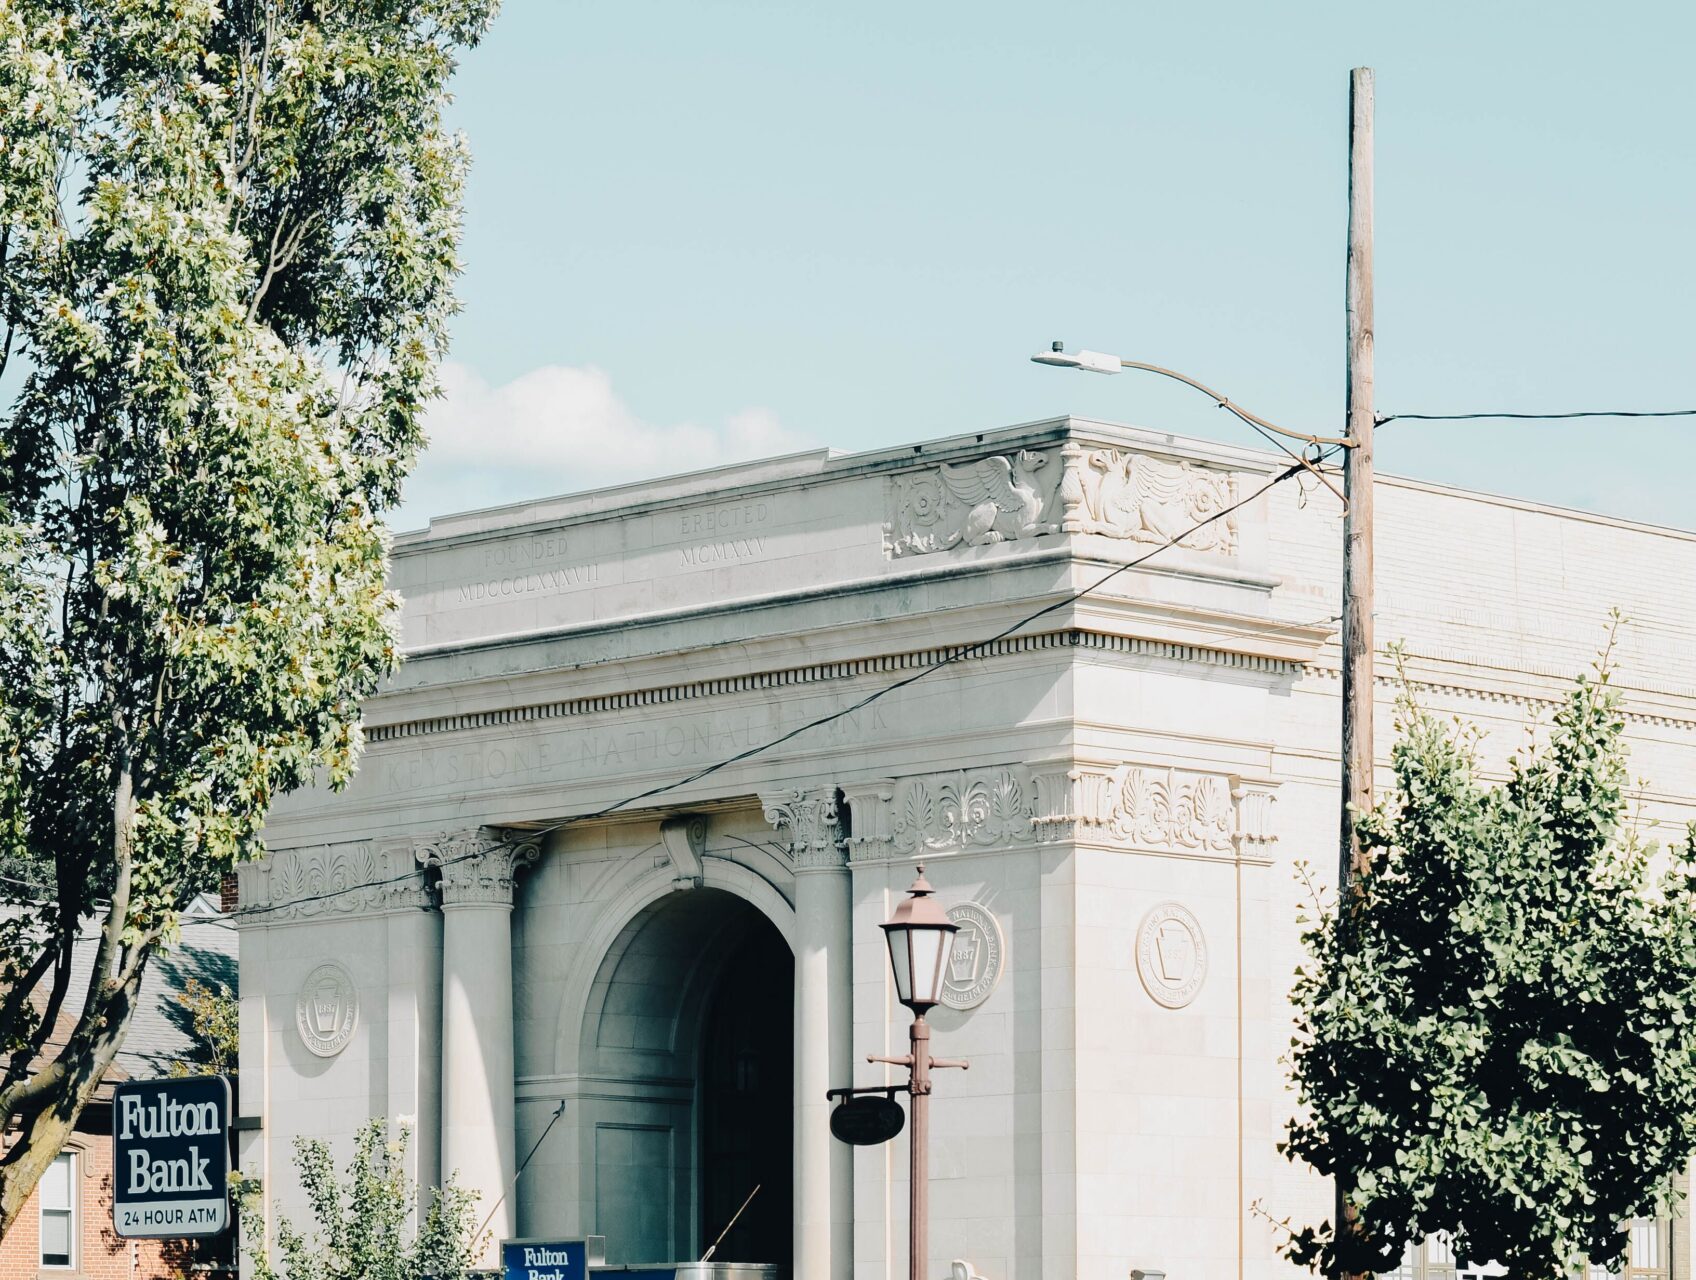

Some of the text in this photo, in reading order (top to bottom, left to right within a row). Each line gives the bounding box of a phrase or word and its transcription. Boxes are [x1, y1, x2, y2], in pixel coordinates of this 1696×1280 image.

[680, 503, 768, 535] ERECTED
[484, 538, 568, 568] FOUNDED
[680, 536, 768, 567] MCMXXV
[457, 562, 600, 602] MDCCCLXXXVII
[386, 743, 552, 792] KEYSTONE
[580, 714, 760, 769] NATIONAL
[952, 948, 975, 962] 1887
[119, 1092, 221, 1140] Fulton
[127, 1146, 213, 1194] Bank
[124, 1207, 217, 1226] 24 HOUR ATM
[523, 1247, 569, 1267] Fulton
